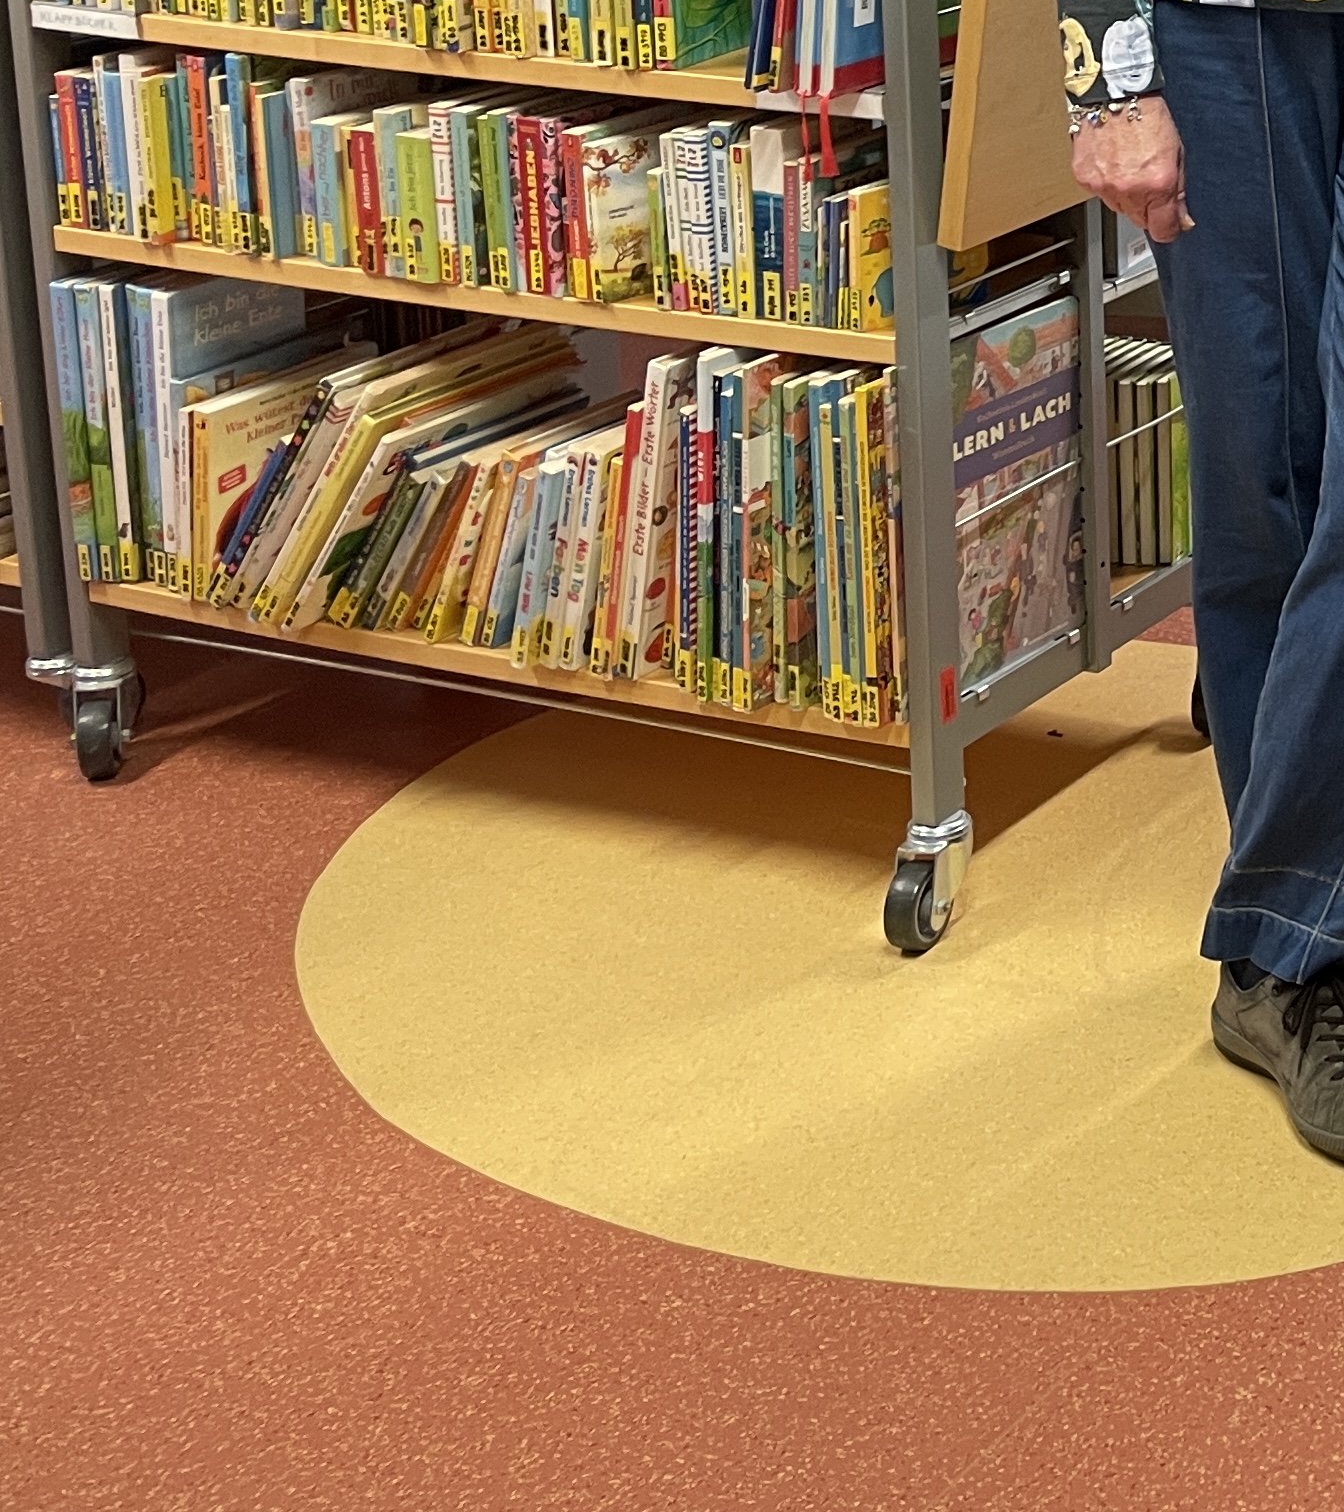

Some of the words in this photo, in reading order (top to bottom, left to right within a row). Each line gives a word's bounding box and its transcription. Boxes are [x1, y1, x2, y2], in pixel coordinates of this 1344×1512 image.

[952, 420, 1005, 463] LERN
[1020, 391, 1072, 432] LACH
[632, 522, 646, 556] Erste
[641, 432, 655, 465] Erste
